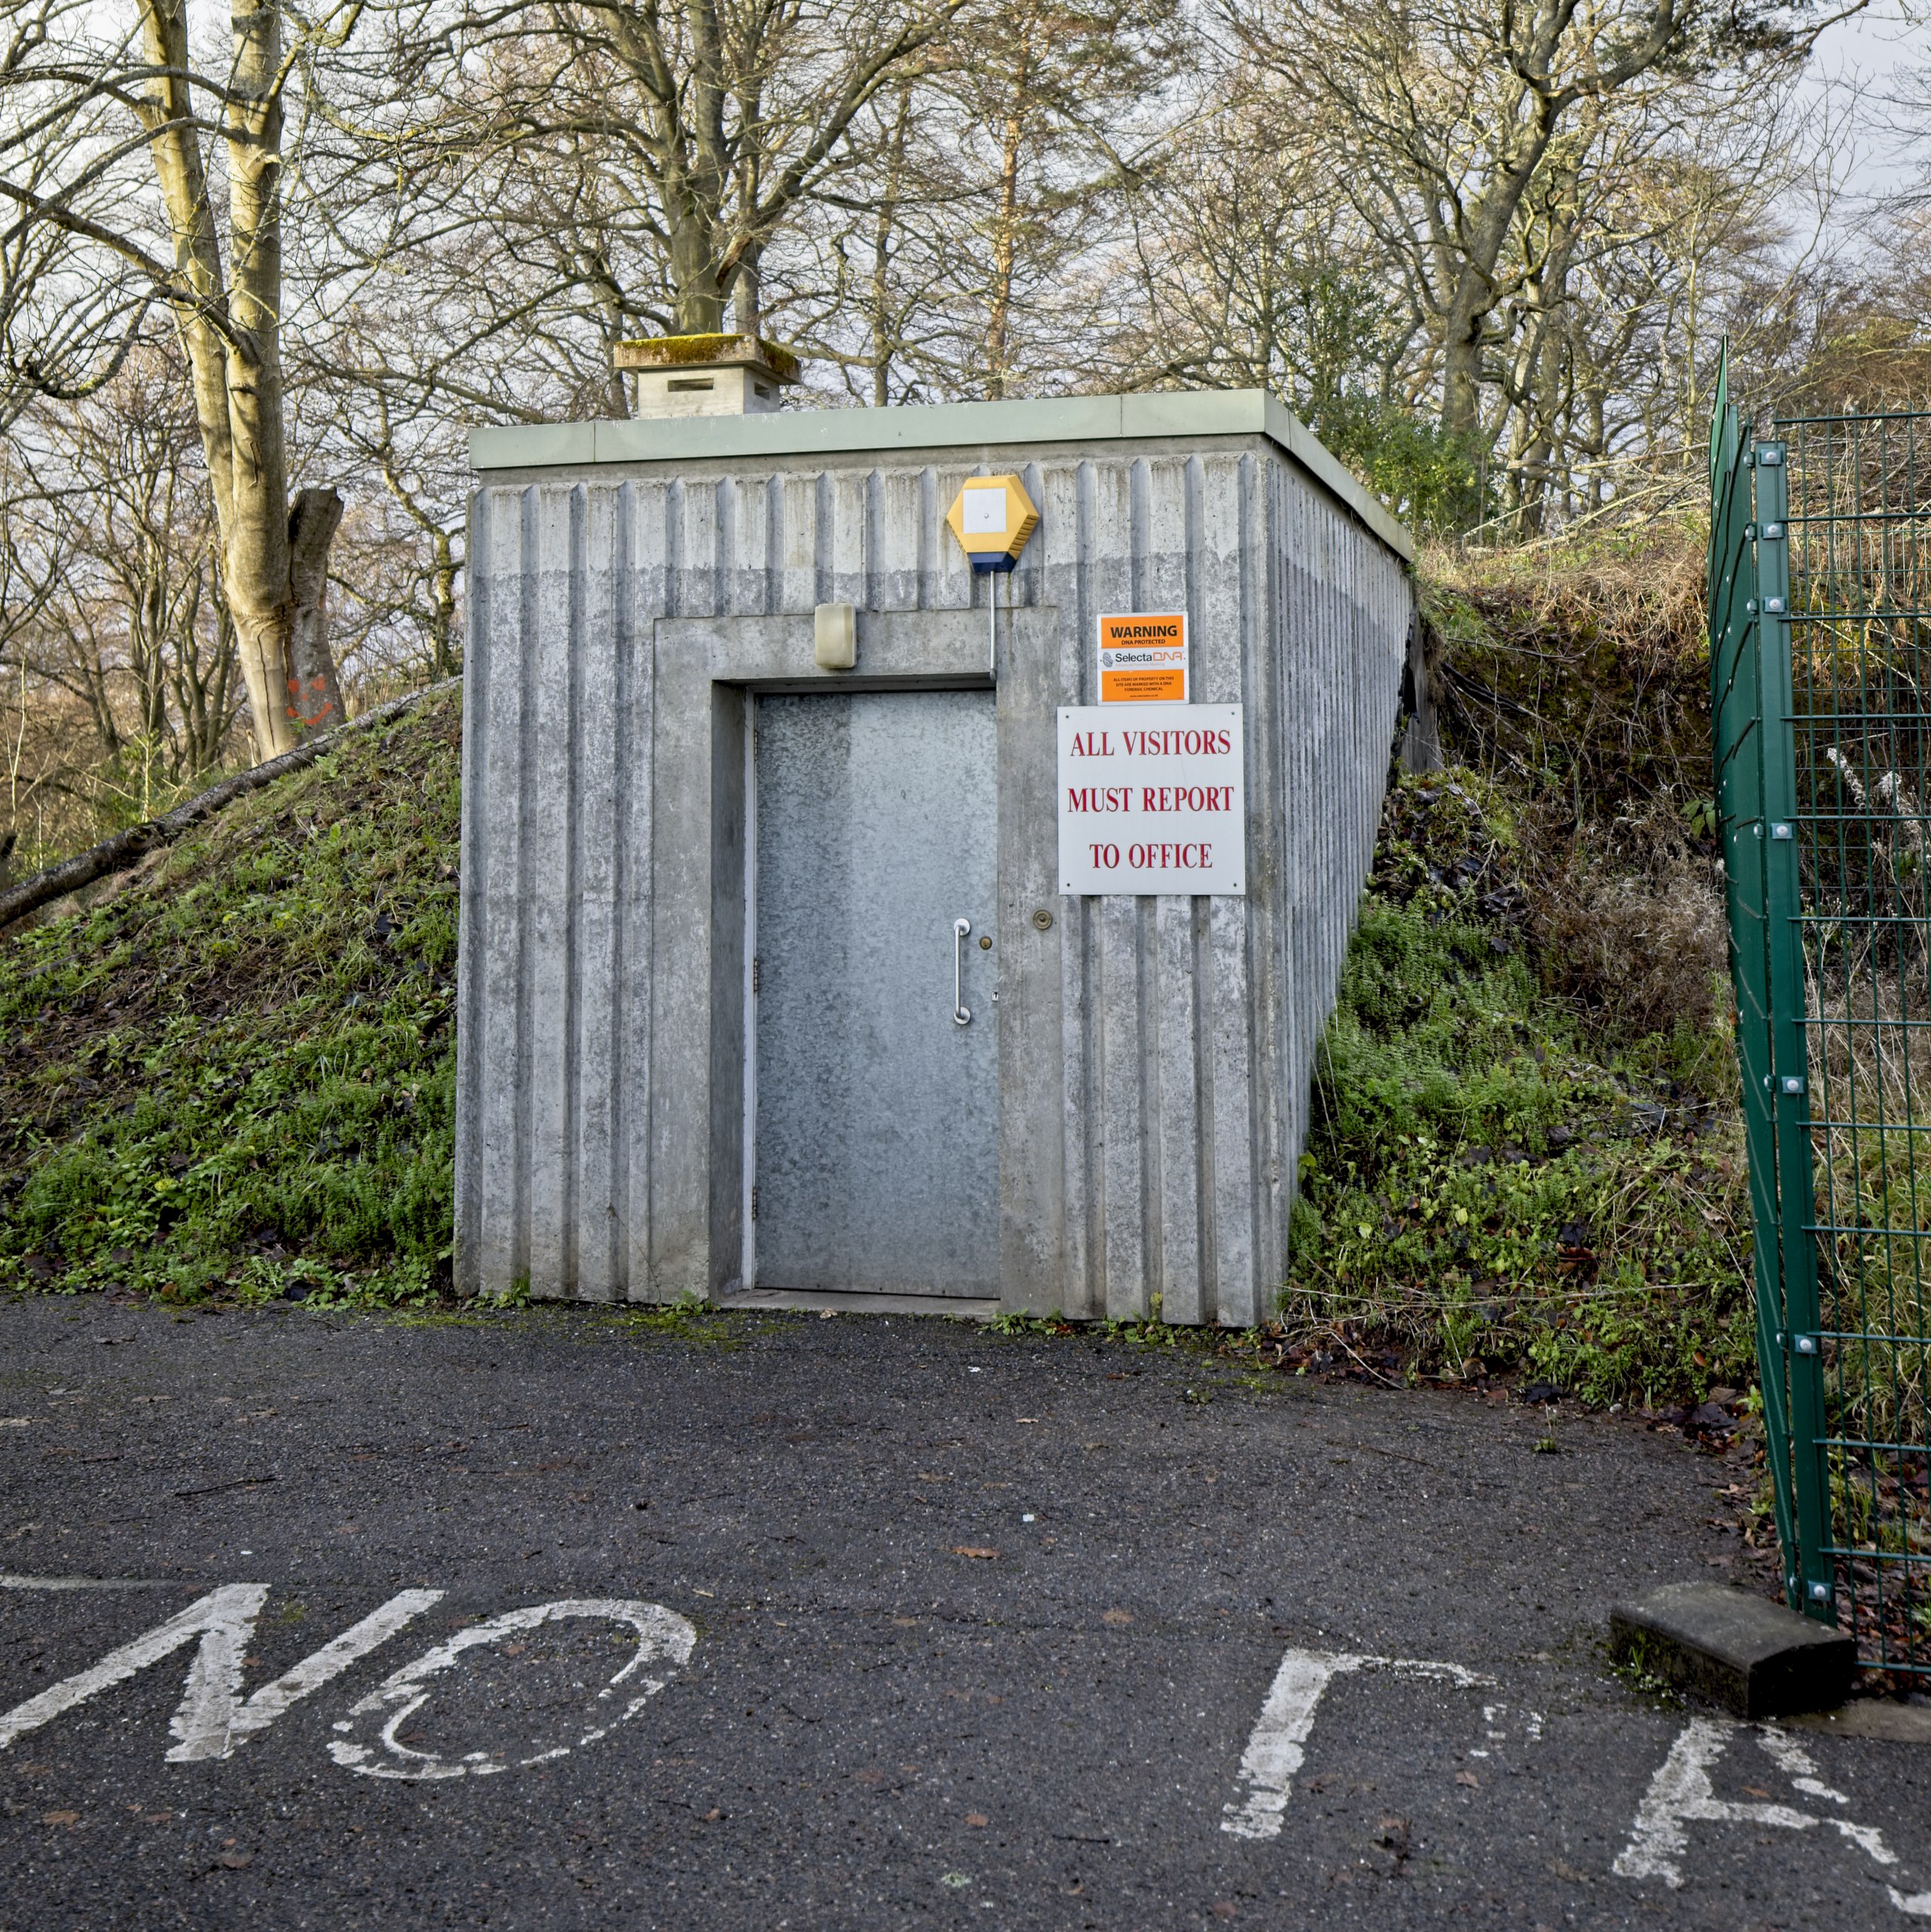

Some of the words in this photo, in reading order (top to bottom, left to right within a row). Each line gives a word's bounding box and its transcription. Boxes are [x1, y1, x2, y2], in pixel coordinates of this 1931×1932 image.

[1111, 625, 1177, 638] WARNING
[1070, 731, 1115, 756] ALL
[1122, 729, 1231, 755] VISITORS
[1067, 787, 1133, 813] MUST
[1142, 786, 1235, 812] REPORT
[1089, 843, 1120, 869] TO
[1128, 843, 1213, 869] OFFICE
[0, 1583, 696, 1780] NO
